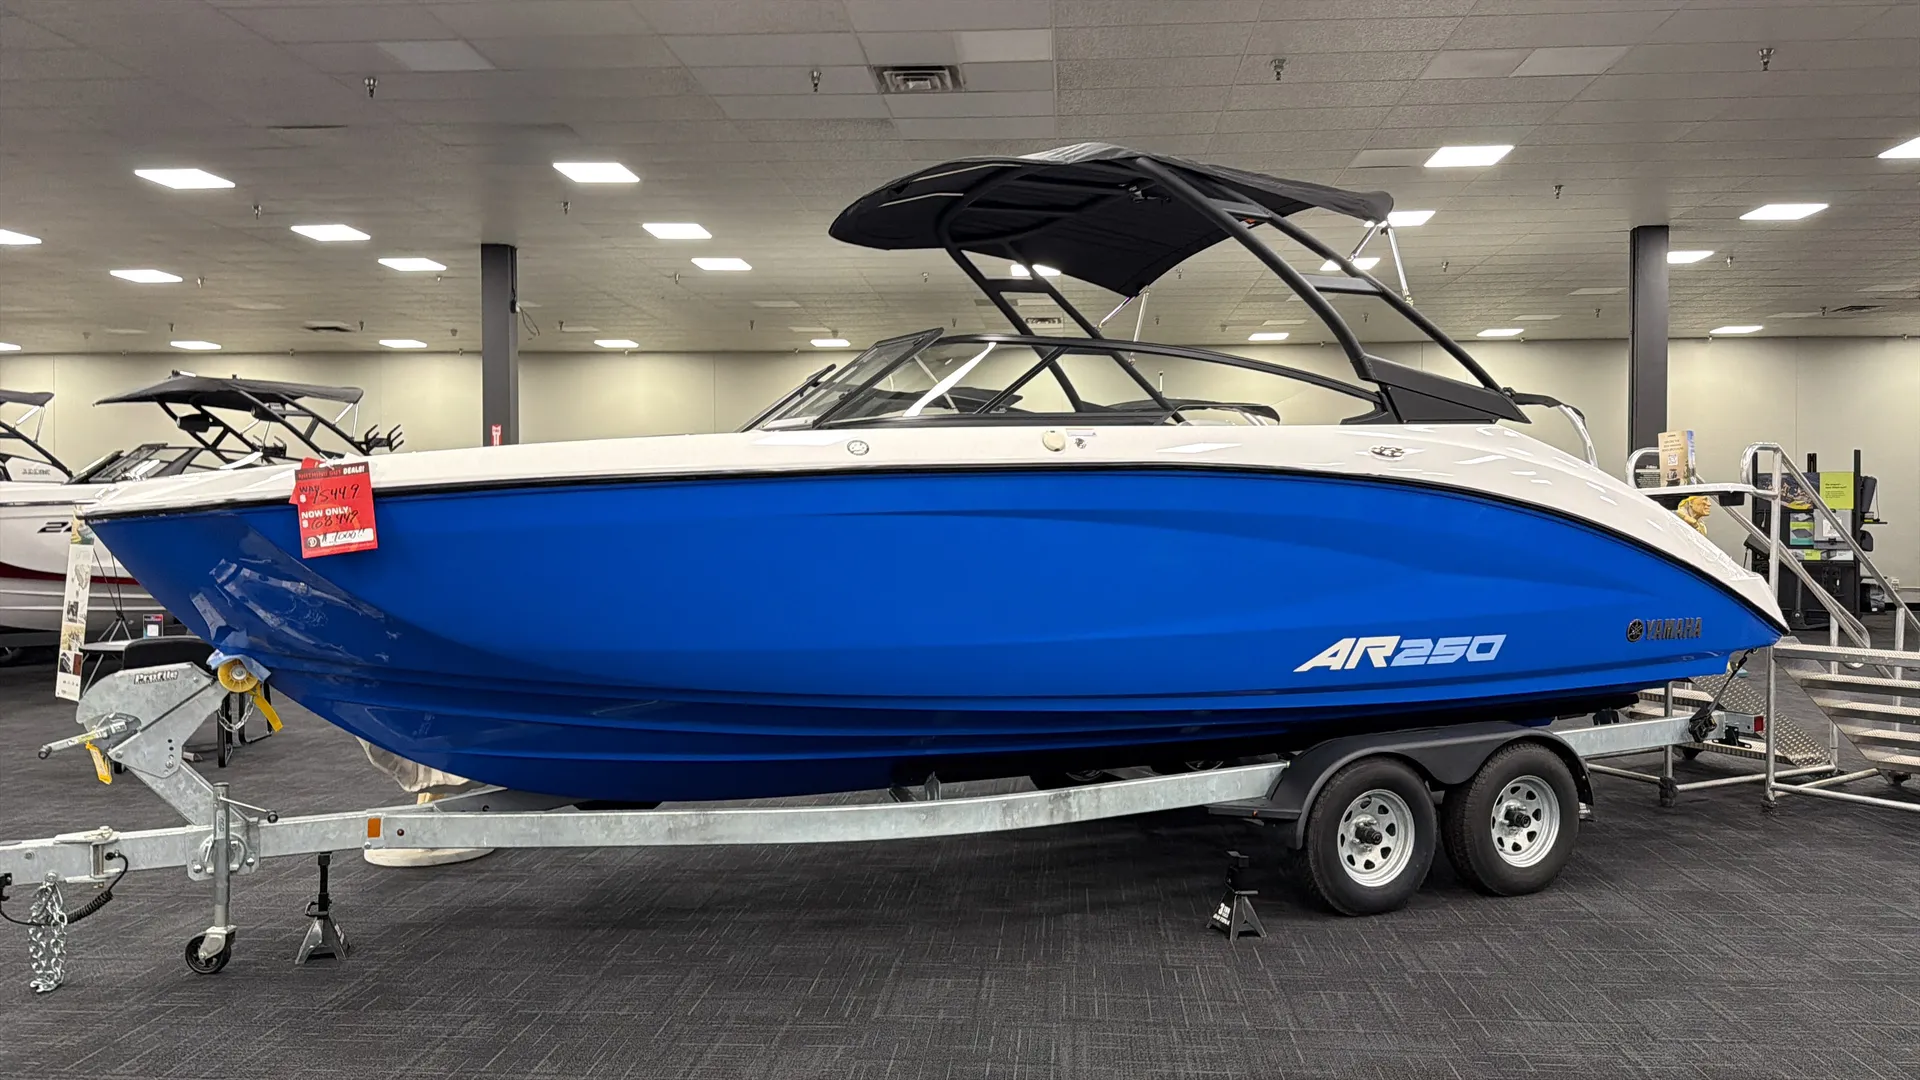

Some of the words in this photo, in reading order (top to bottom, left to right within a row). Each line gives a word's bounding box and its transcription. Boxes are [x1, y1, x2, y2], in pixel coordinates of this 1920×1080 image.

[343, 465, 365, 475] DEALS!
[301, 510, 323, 519] NOW
[37, 522, 72, 534] 2
[1645, 617, 1702, 640] YAMAHA
[1293, 634, 1507, 672] AR250
[133, 670, 179, 685] Profile
